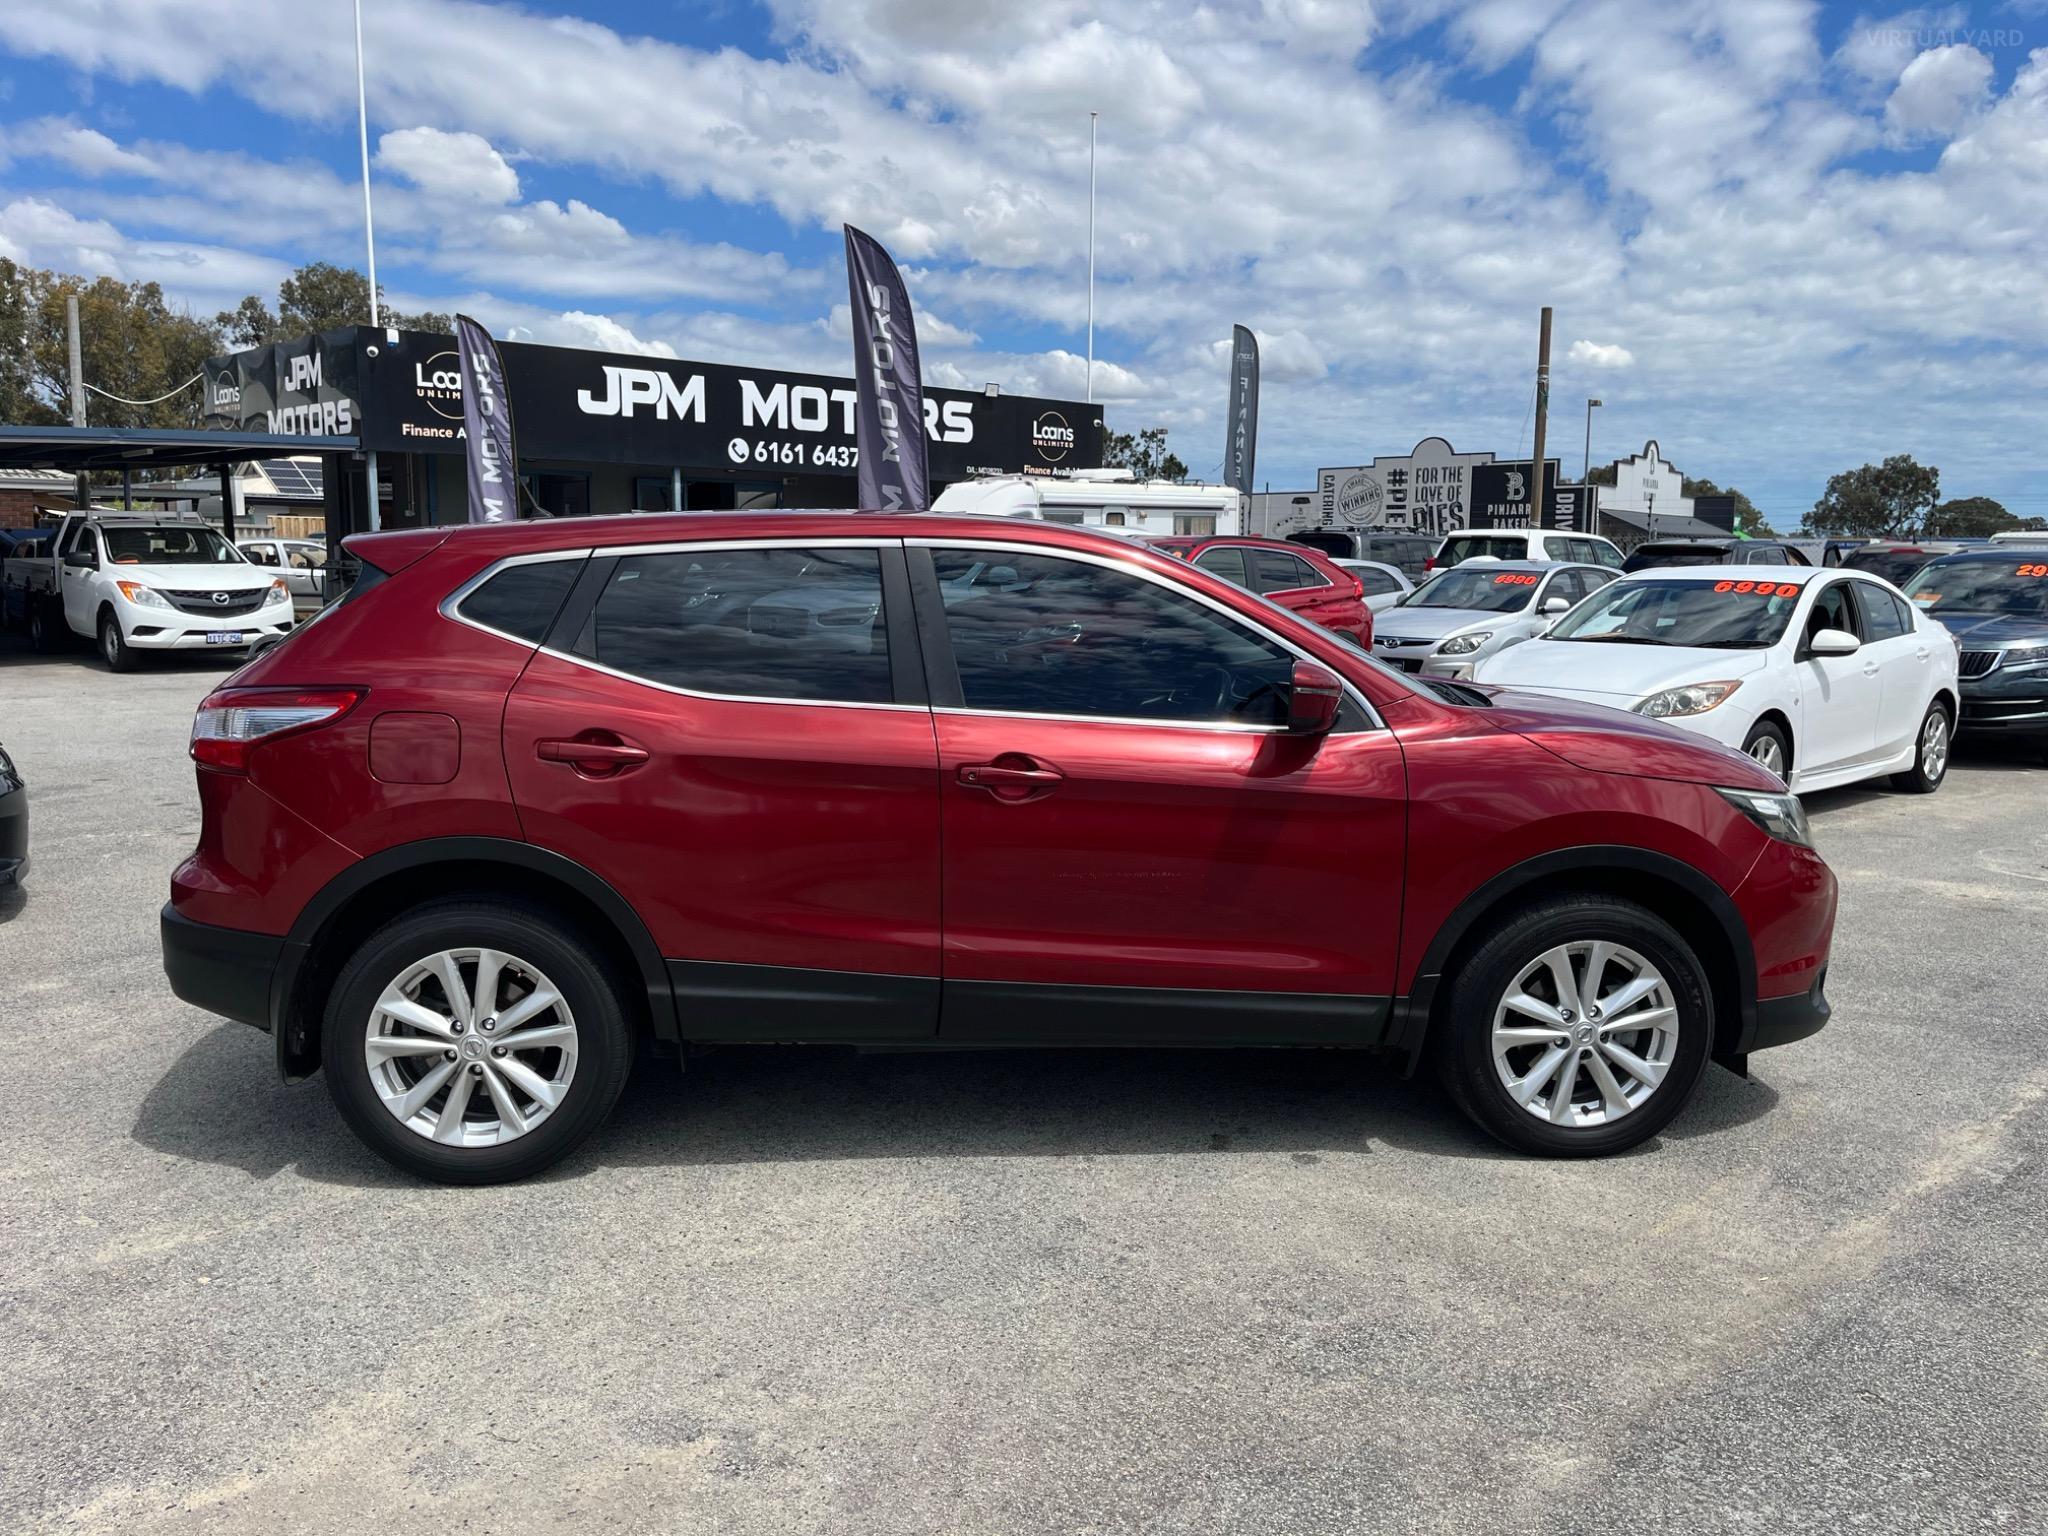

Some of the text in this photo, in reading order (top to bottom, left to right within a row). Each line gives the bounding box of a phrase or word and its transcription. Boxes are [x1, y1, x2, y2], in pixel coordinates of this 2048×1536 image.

[284, 352, 323, 392] JPM
[415, 363, 462, 390] Loa
[213, 384, 241, 406] Loans
[416, 389, 461, 400] UNLIM
[577, 365, 974, 444] JPM MOTRS
[267, 399, 353, 436] MOTORS
[402, 423, 454, 439] Finance
[1033, 420, 1075, 442] Loans
[754, 441, 859, 468] 6161 6437
[1033, 439, 1075, 449] UNLIMITED
[1023, 464, 1052, 476] Finance
[1415, 465, 1464, 484] FOR THE
[1321, 474, 1336, 526] CATERING
[1340, 486, 1382, 512] WINNING
[1414, 485, 1463, 504] LOVE OF
[1412, 501, 1465, 537] PIES
[1487, 503, 1532, 516] PINJARR
[1554, 493, 1576, 531] DRIV
[1493, 574, 1539, 586] 6990
[2015, 564, 2048, 577] 29
[1713, 580, 1800, 598] 6990
